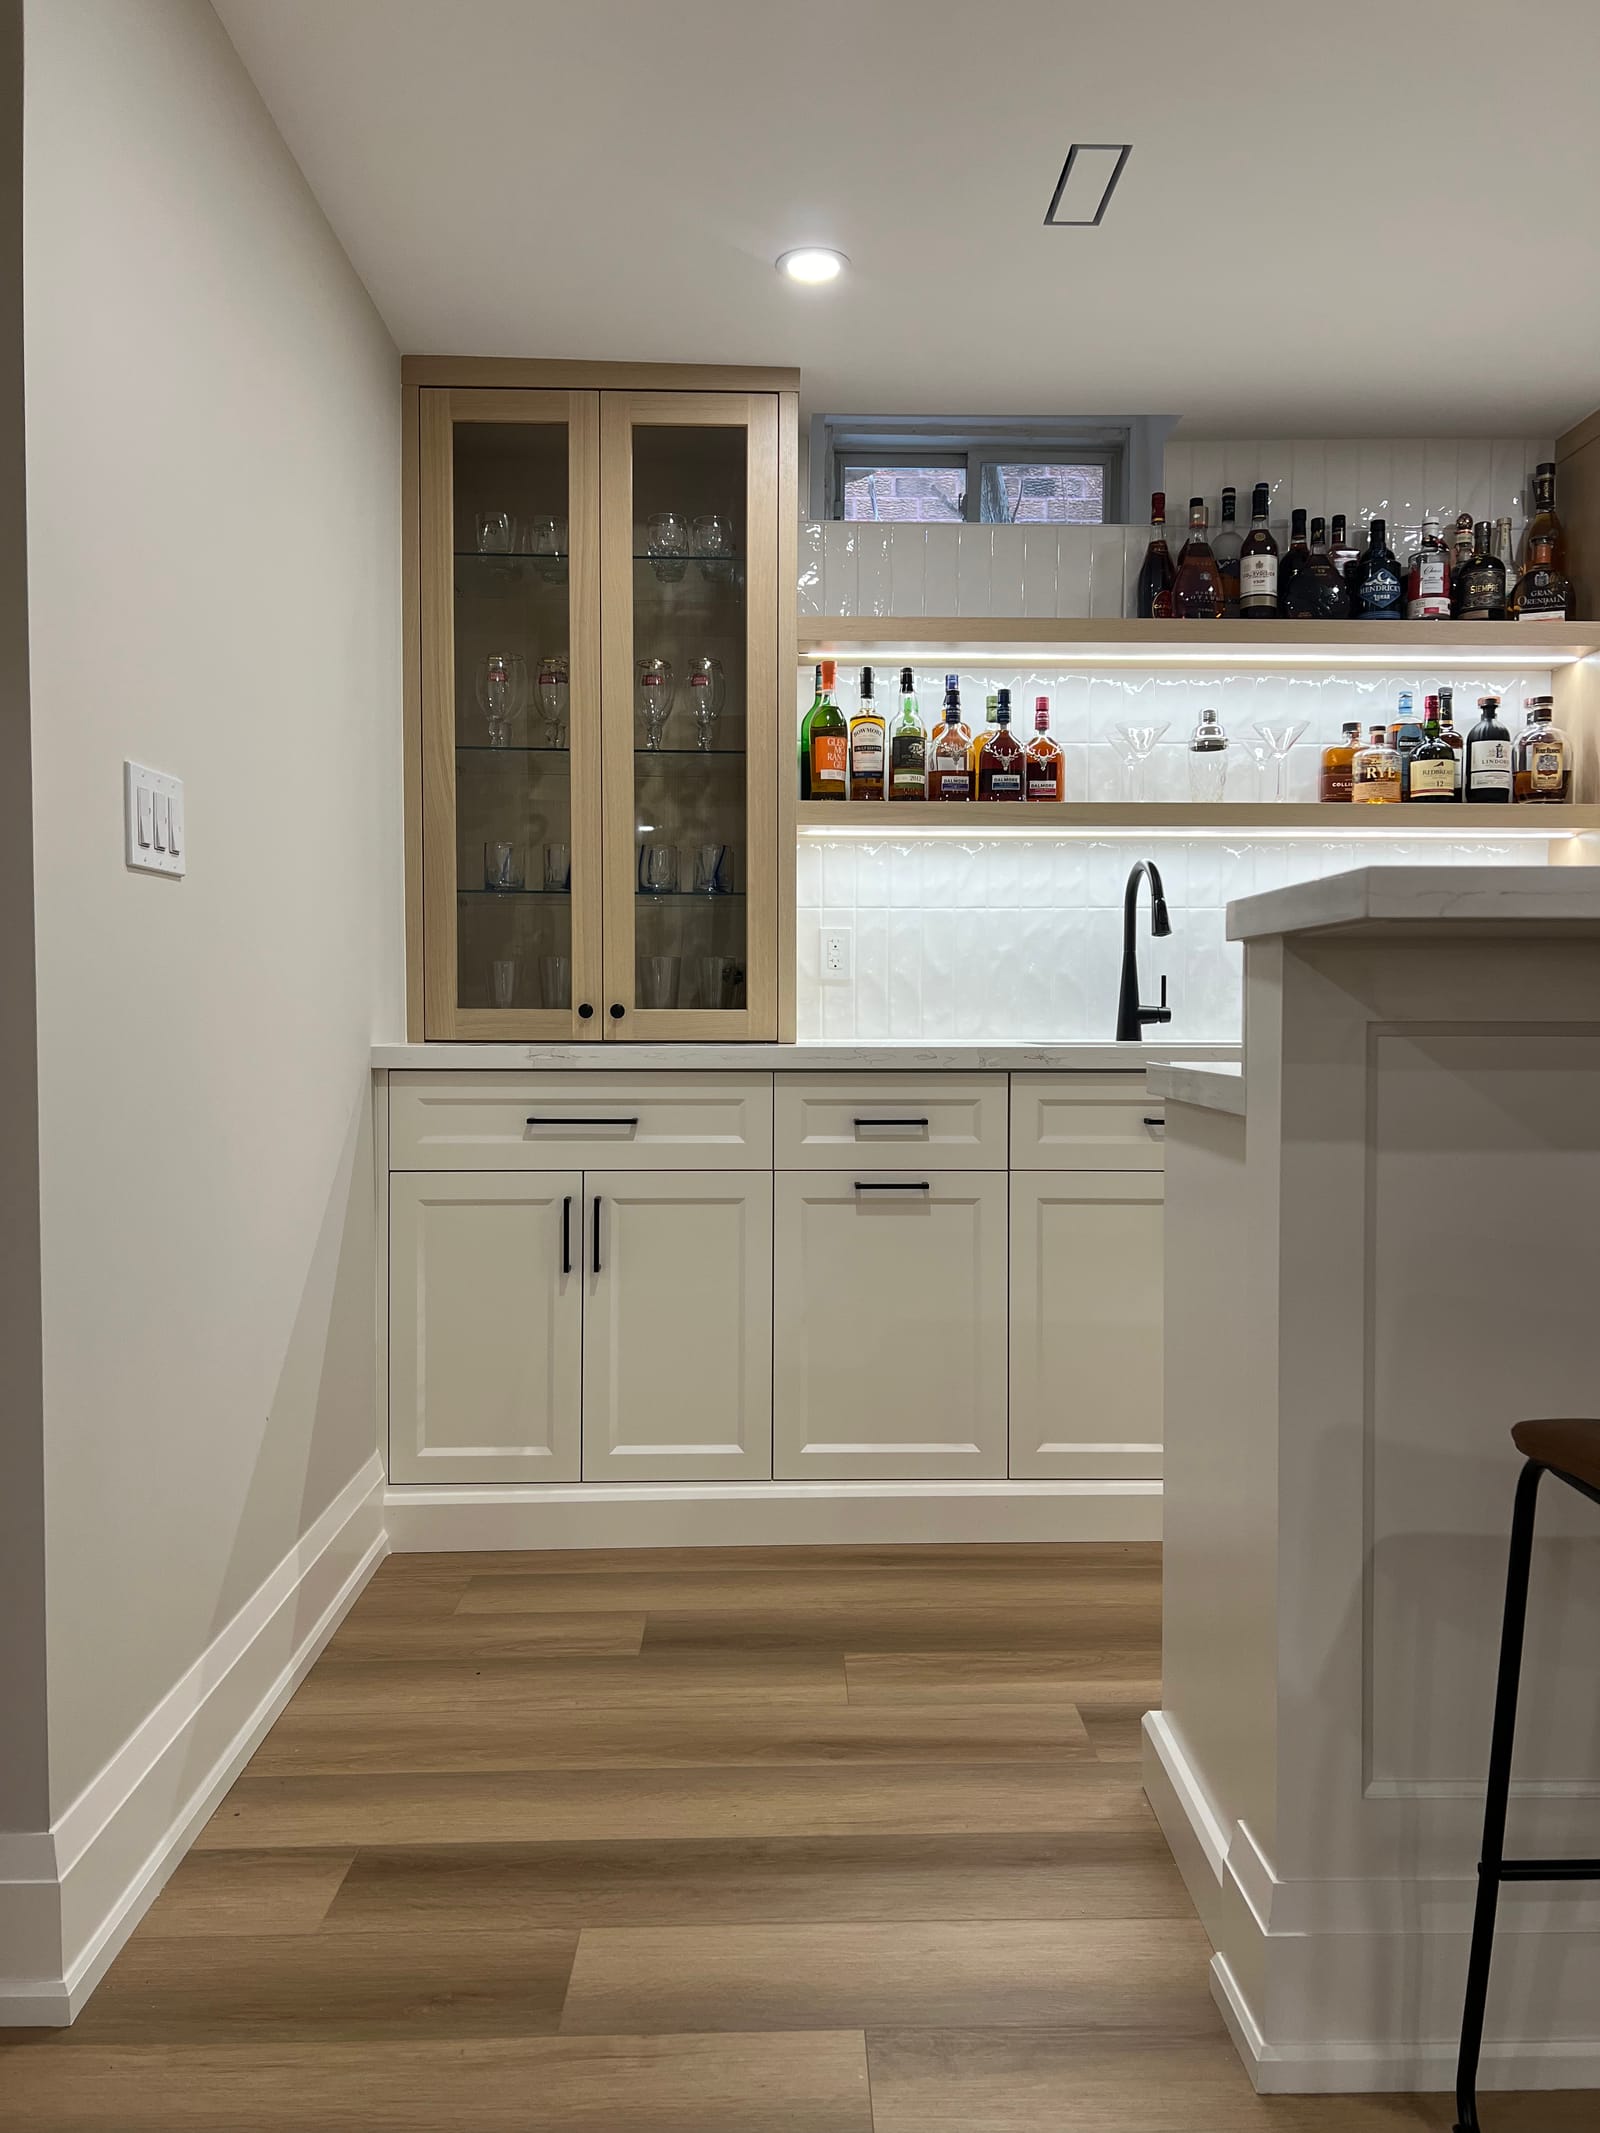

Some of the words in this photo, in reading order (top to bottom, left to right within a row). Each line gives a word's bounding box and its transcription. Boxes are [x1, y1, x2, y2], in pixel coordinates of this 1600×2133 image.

[1470, 584, 1499, 594] SIEMPRE
[1530, 589, 1553, 597] GRAN
[1366, 766, 1396, 779] RYE
